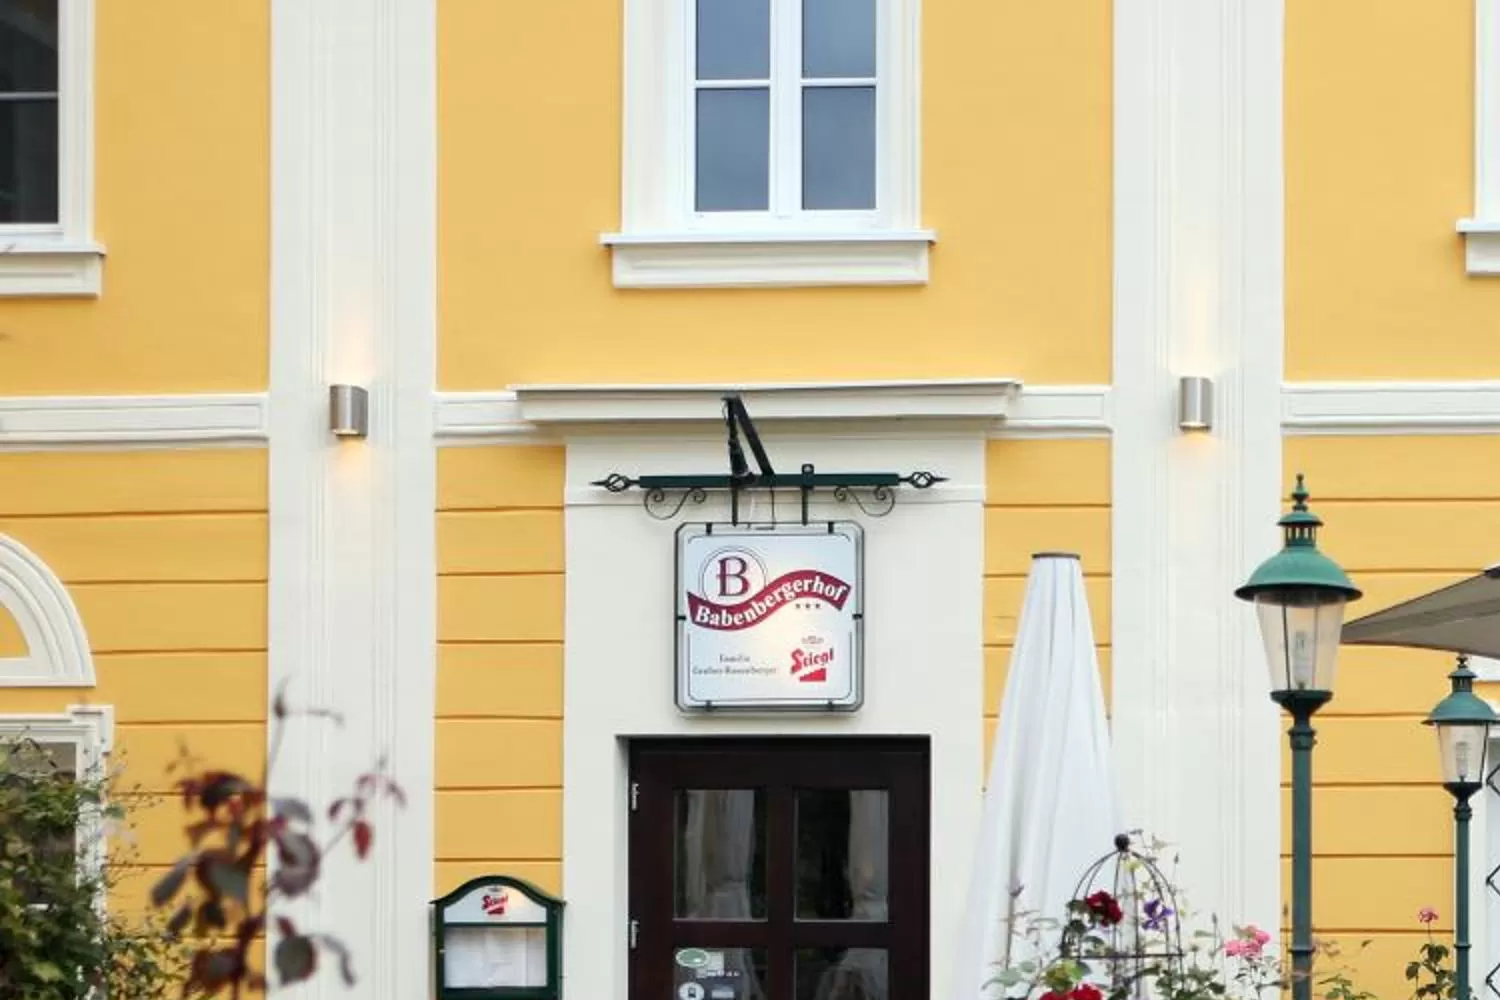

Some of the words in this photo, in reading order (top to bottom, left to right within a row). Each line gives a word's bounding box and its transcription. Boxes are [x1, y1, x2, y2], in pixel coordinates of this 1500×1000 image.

[716, 556, 750, 597] B
[695, 575, 847, 628] Babenbergerhof
[790, 647, 834, 675] Stiegl
